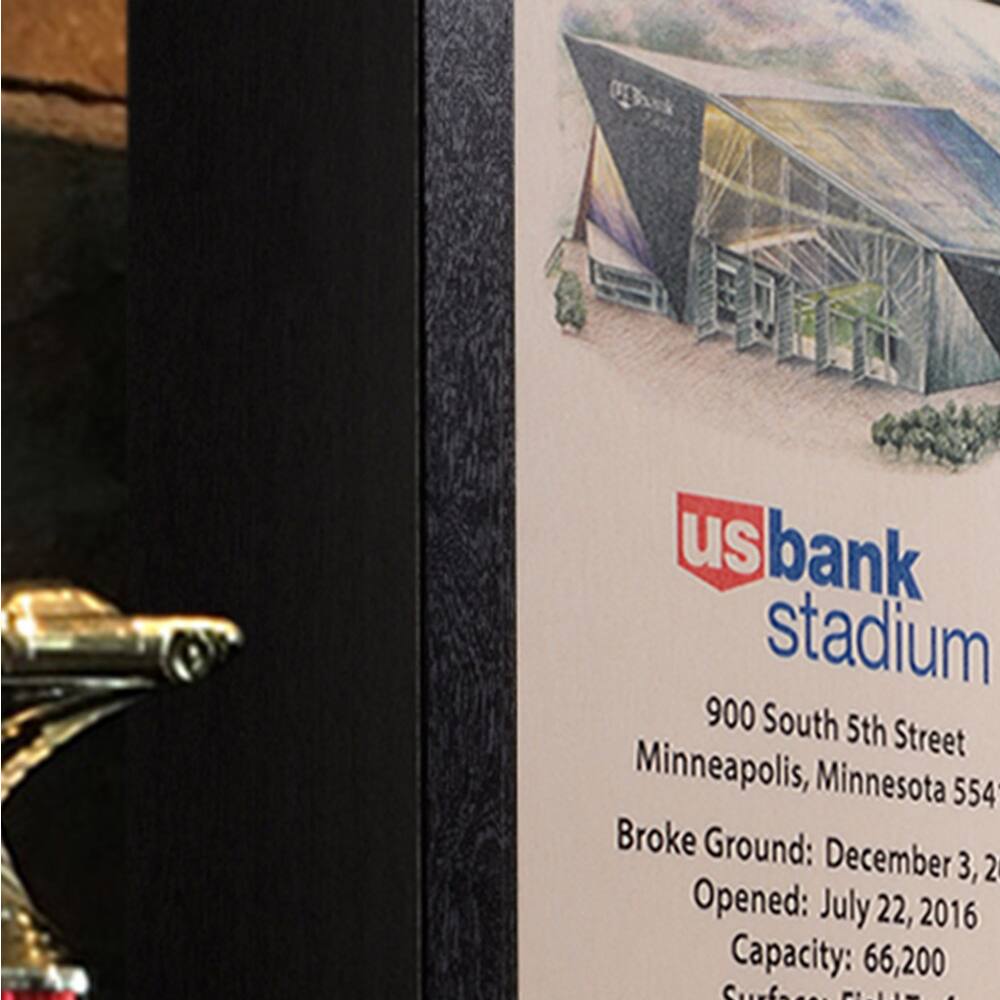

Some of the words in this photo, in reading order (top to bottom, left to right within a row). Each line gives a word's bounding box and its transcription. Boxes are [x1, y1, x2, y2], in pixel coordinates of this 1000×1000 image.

[766, 591, 991, 686] stadium
[705, 695, 757, 732] 900
[763, 701, 839, 742] South
[846, 713, 888, 747] 5th
[894, 718, 966, 757] Street
[635, 739, 810, 793] Minneapolis,
[816, 759, 946, 804] Minnesota
[616, 817, 697, 857] Broke
[703, 825, 813, 867] Ground:
[825, 836, 951, 879] December
[958, 850, 979, 886] 3,
[692, 877, 808, 919] Opened:
[819, 887, 871, 930] July
[877, 892, 913, 930] 22,
[919, 896, 979, 930] 2016
[731, 932, 852, 979] Capacity:
[863, 942, 947, 979] 66,200
